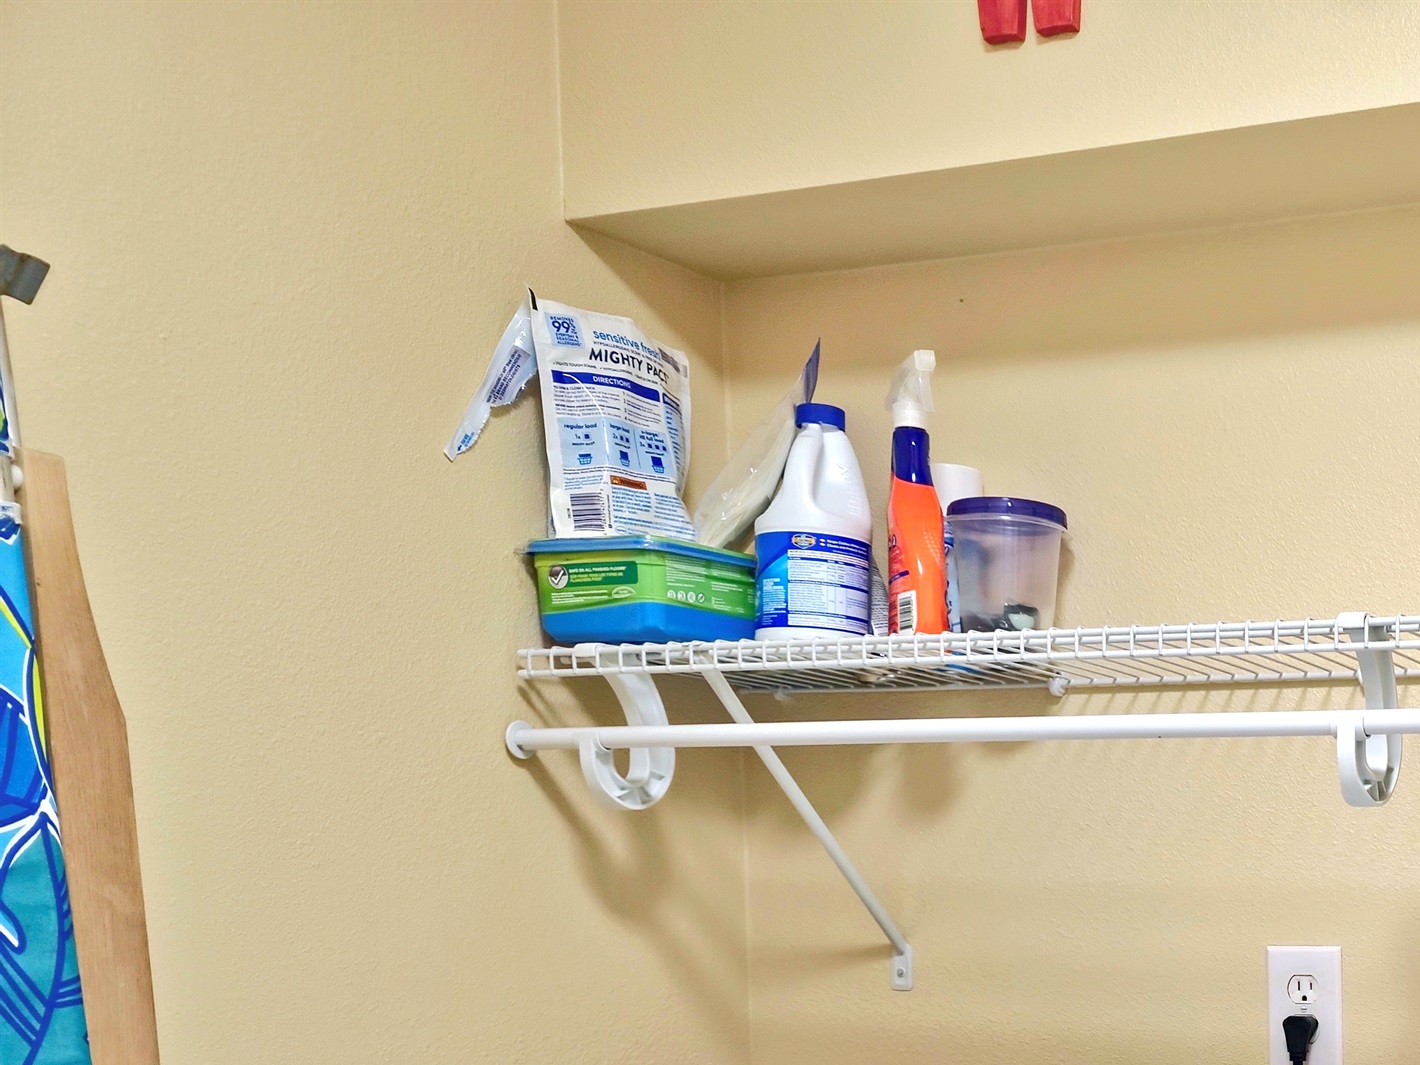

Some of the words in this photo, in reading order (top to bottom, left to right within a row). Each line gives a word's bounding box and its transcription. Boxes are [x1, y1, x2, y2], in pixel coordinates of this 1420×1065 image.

[593, 330, 640, 350] sensitive
[588, 348, 643, 371] MIGHTY
[592, 376, 632, 389] DIRECTIONS
[563, 422, 584, 430] regular
